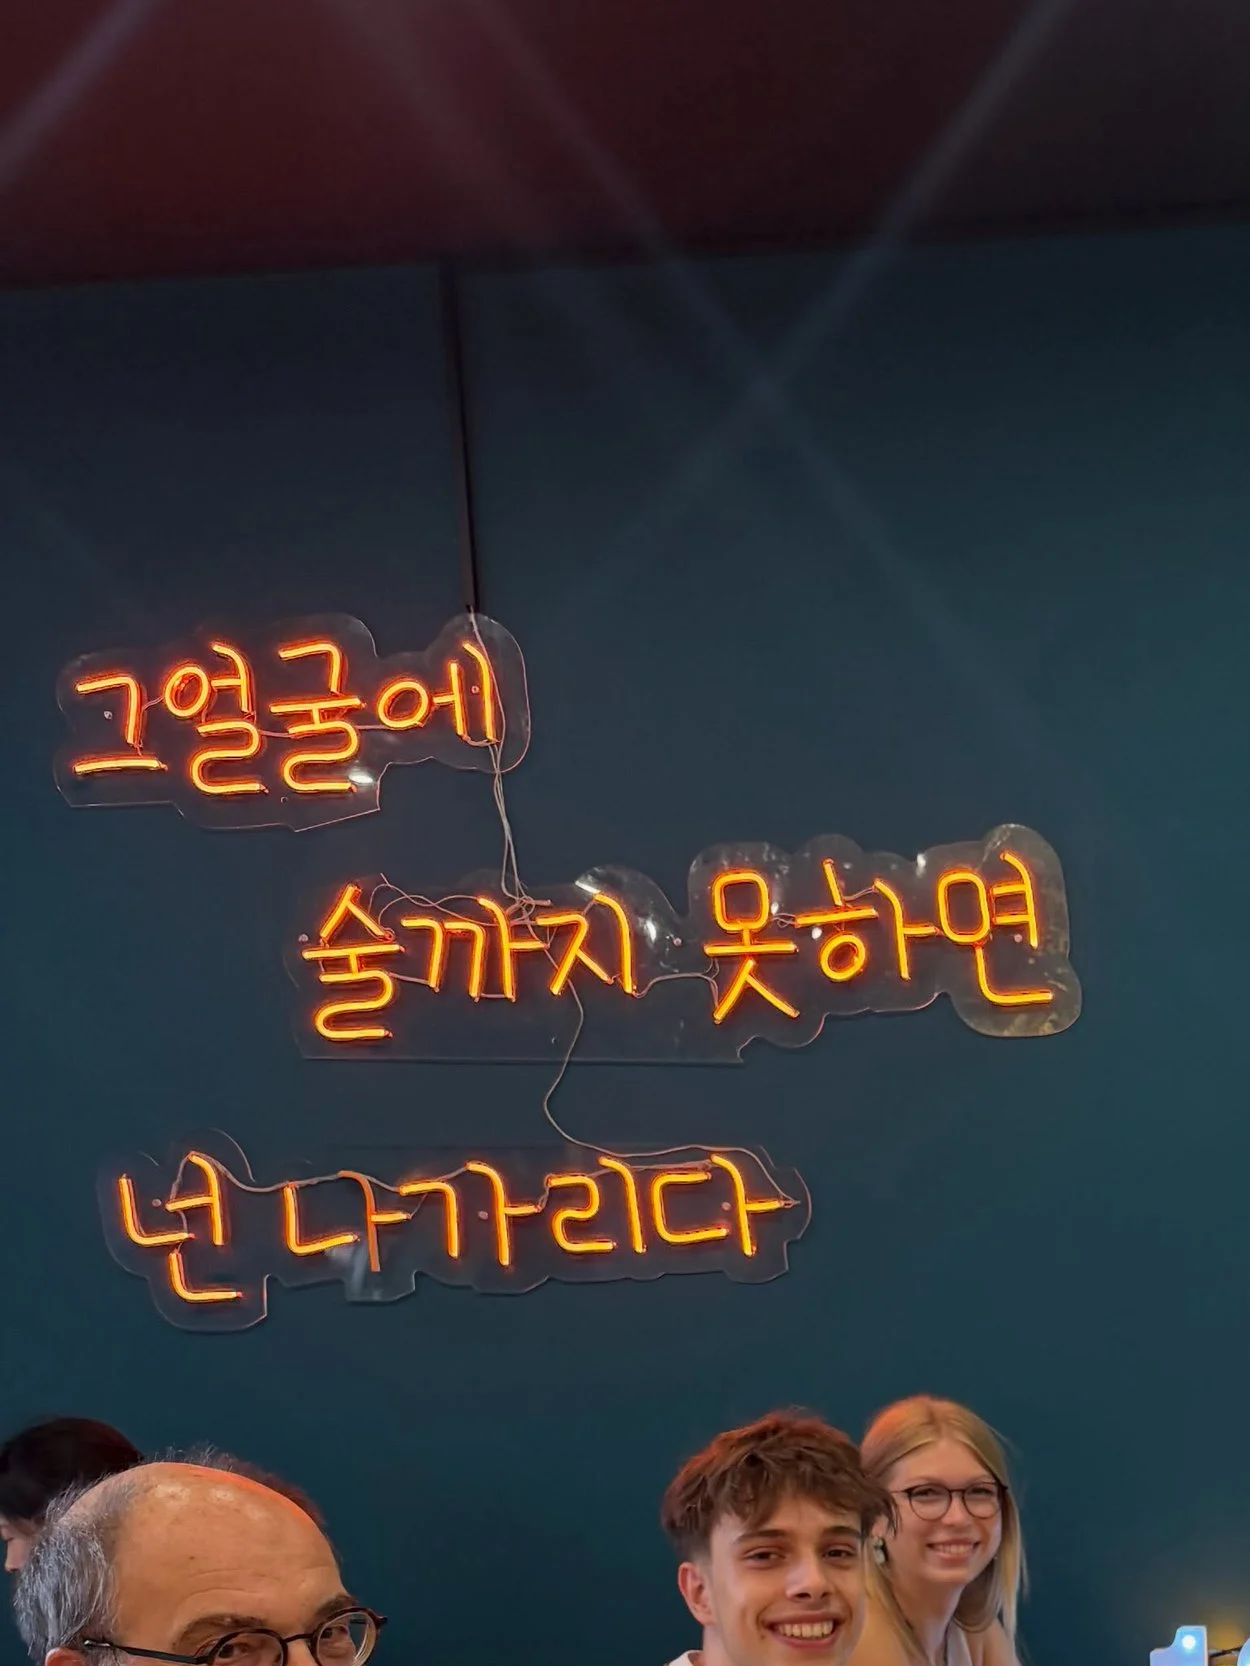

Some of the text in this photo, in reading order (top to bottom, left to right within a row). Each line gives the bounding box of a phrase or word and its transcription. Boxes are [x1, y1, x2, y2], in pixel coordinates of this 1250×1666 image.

[301, 849, 1055, 1041] 술까지 못하면
[117, 1151, 787, 1303] 넌 나가리다
